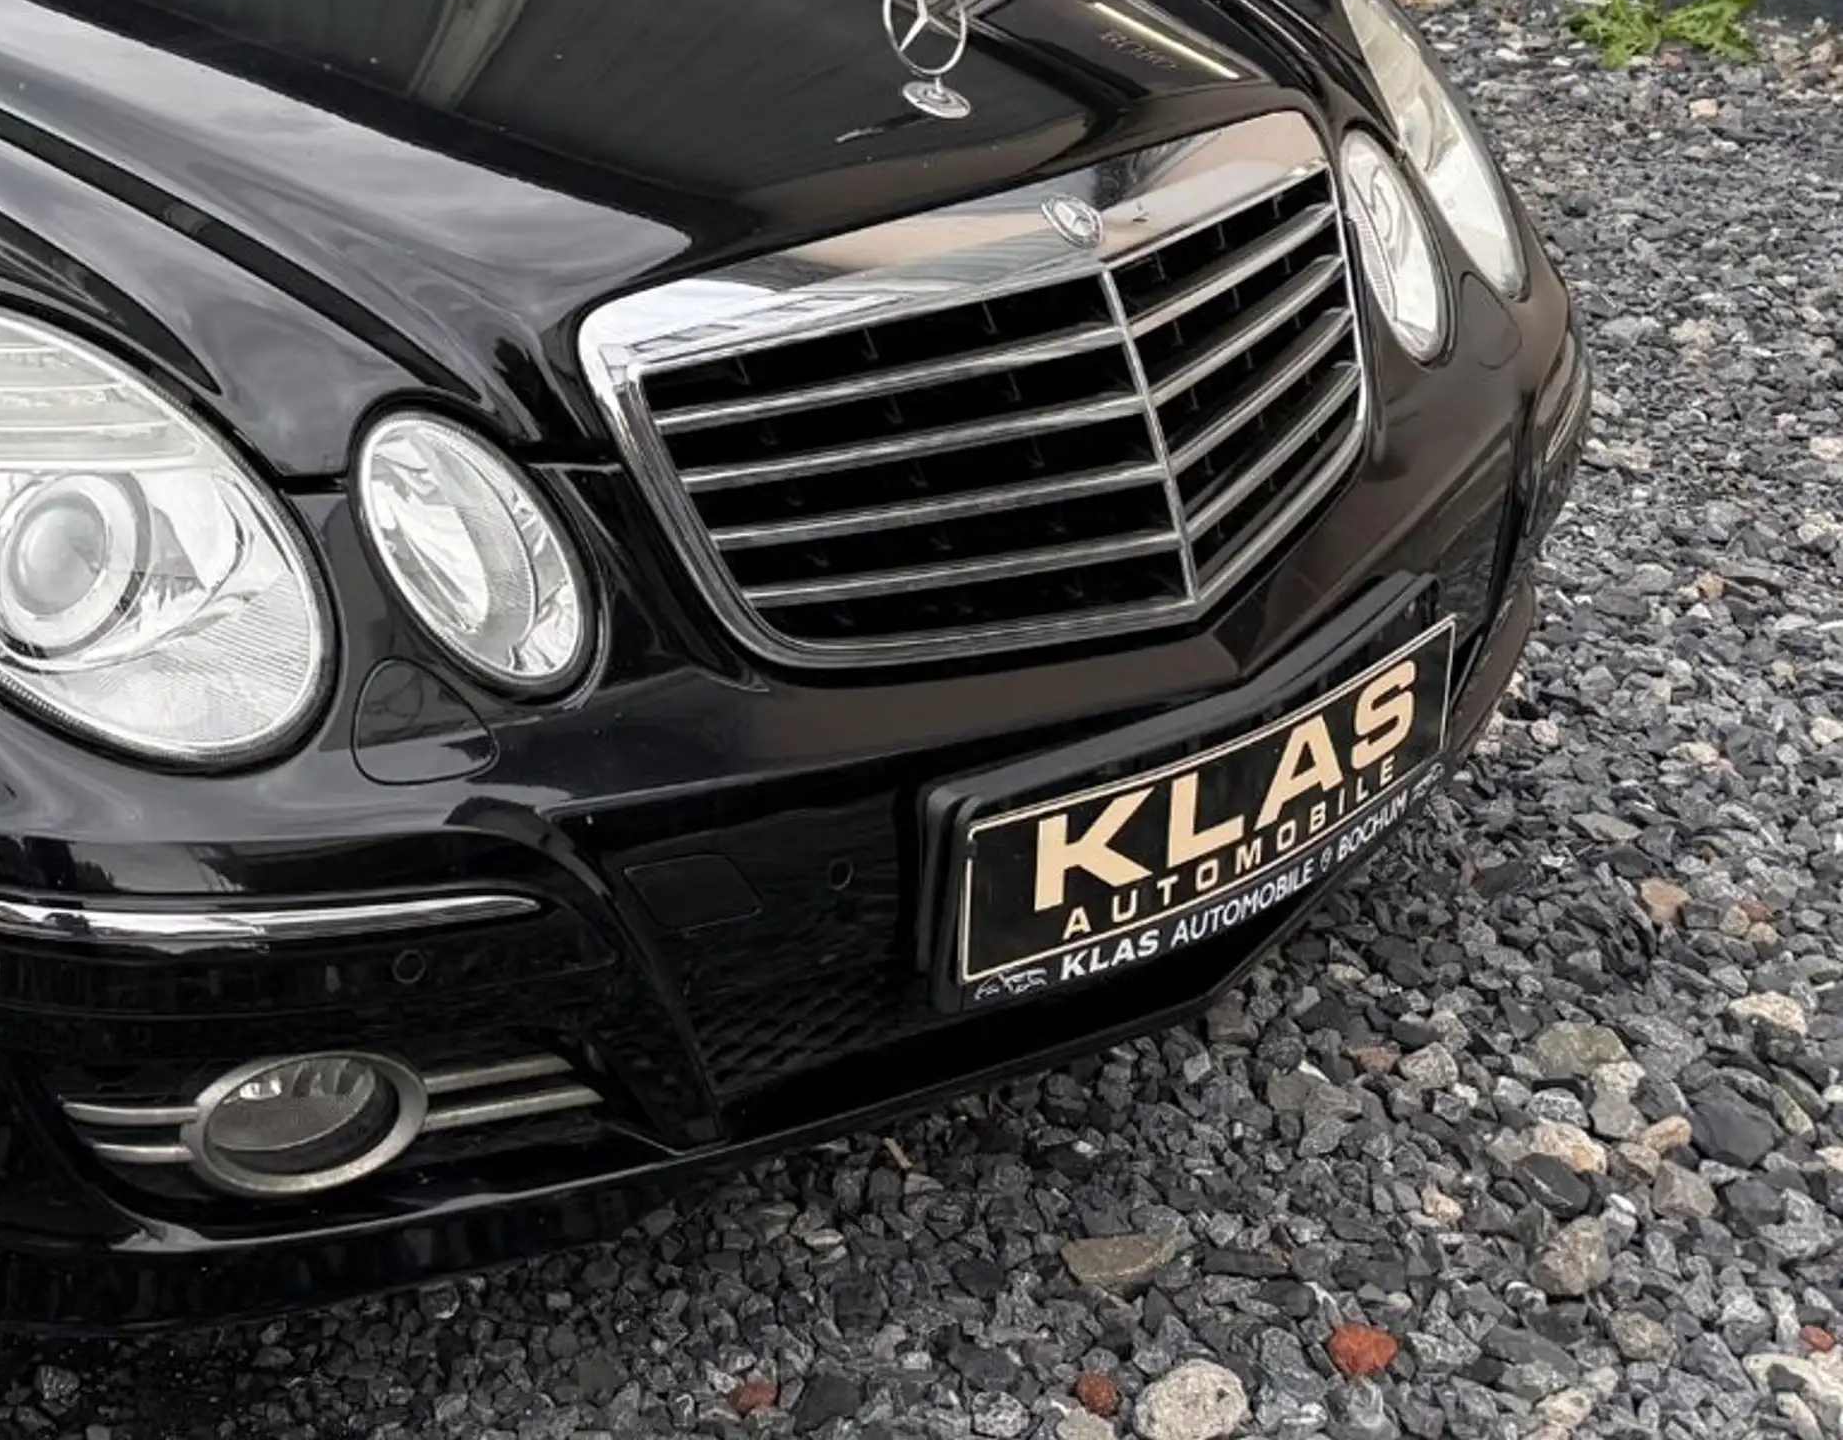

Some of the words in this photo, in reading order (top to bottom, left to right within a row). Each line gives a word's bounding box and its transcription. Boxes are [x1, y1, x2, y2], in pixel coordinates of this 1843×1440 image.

[1035, 660, 1417, 912] KLAS
[1062, 755, 1395, 940] AUTOMOBILE
[1060, 928, 1159, 981] KLAS
[1171, 858, 1314, 944] AUTOMOBILE
[1337, 790, 1407, 861] BOCHUM
